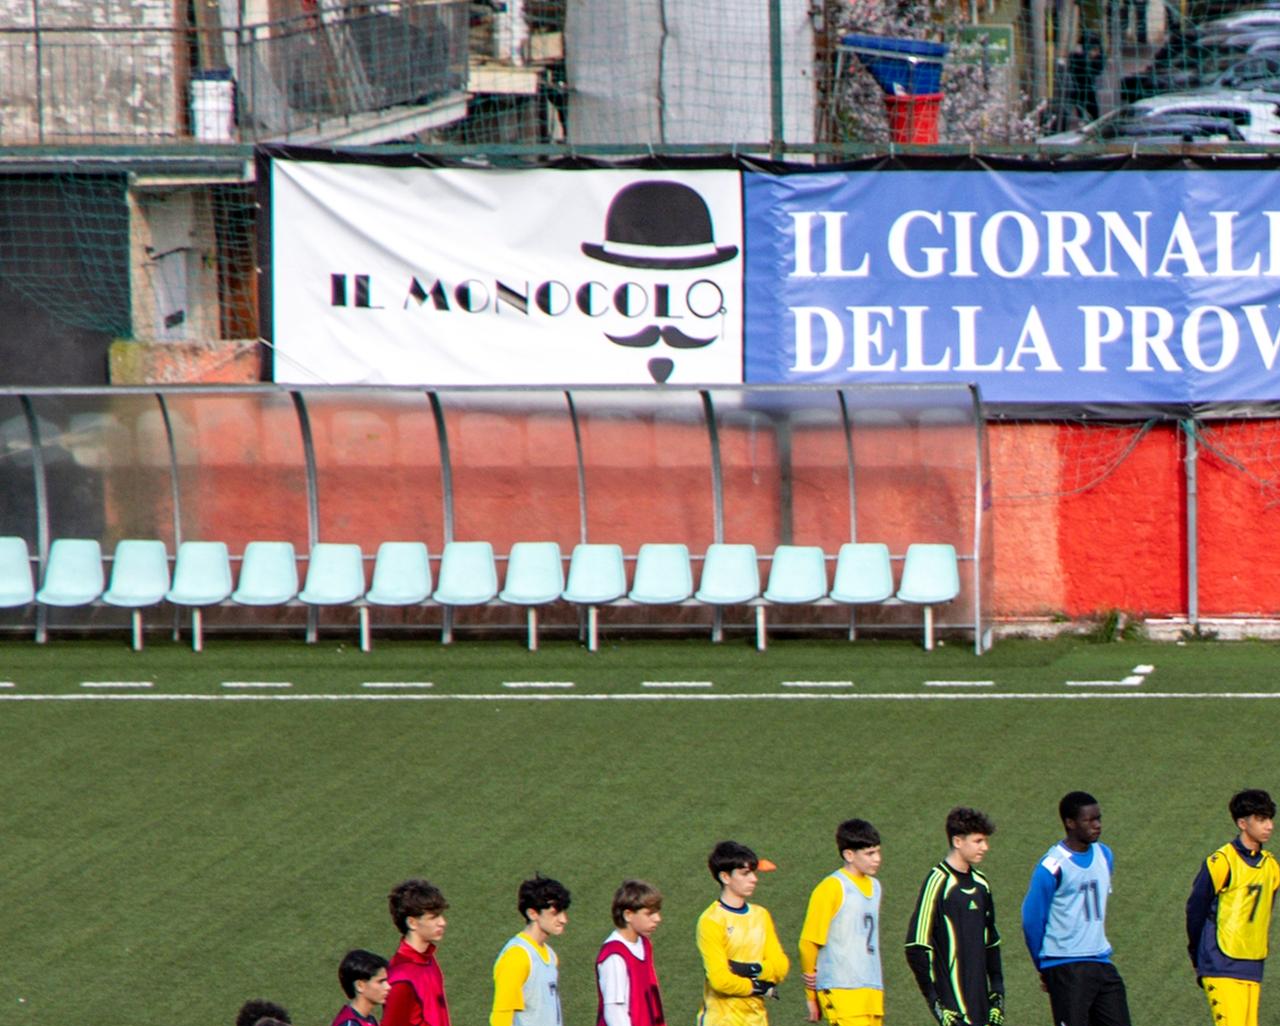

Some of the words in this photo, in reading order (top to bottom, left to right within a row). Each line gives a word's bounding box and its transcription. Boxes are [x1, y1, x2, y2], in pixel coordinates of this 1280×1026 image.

[788, 210, 870, 278] IL
[331, 273, 385, 310] IL
[404, 276, 726, 319] MONOCOLO
[788, 304, 1063, 372] DELLA
[1080, 879, 1102, 922] 11
[1247, 883, 1263, 923] 7
[863, 914, 875, 956] 2
